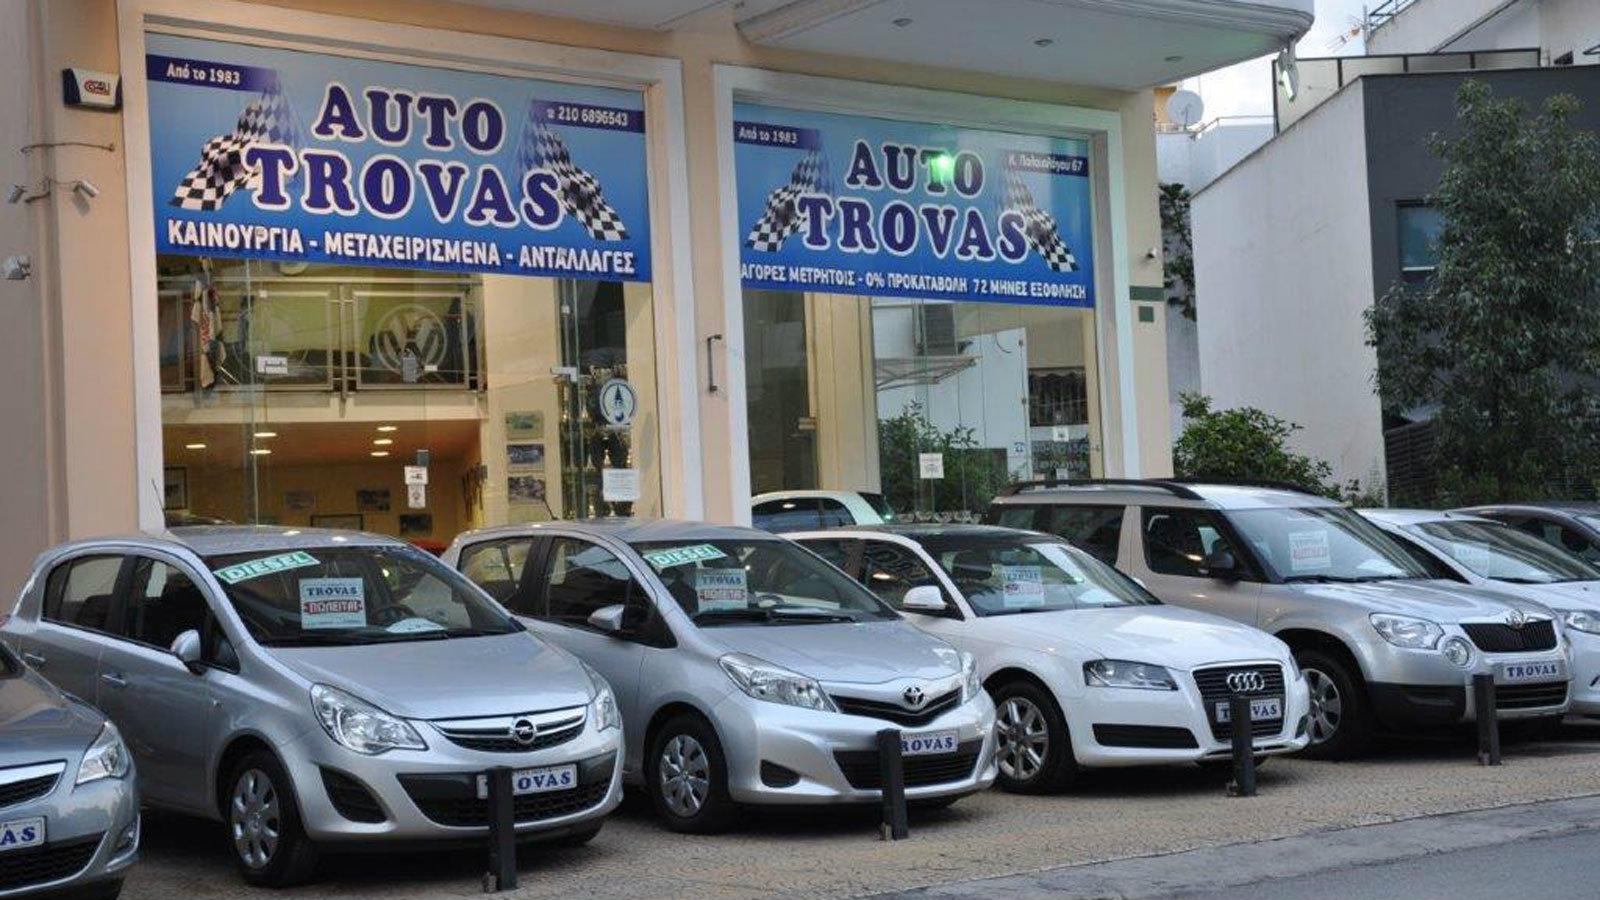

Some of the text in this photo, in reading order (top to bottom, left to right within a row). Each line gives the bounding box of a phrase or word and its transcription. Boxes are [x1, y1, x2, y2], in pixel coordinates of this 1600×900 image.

[166, 62, 240, 84] Από το 1983
[313, 83, 505, 152] AUTO
[558, 106, 578, 121] 210
[772, 130, 797, 144] 1983
[847, 141, 984, 197] AUTO
[1072, 160, 1082, 171] 67
[242, 145, 562, 230] TROVAS
[798, 194, 1028, 263] TROVAS
[168, 219, 303, 253] ΚΑΙΝΟΥΡΓΙΑ
[325, 231, 500, 266] ΜΕΤΑΧΕΙΡΙΣΜΕΝΑ
[741, 263, 786, 281] ΑΓΟΡΕΣ
[789, 266, 855, 286] ΜΕΤΡΗΤΟΙΣ
[866, 273, 885, 288] 0%
[887, 273, 967, 292] ΠΡΟΚΑΤΑΒΟΛΗ
[973, 279, 988, 293] 72
[990, 279, 1028, 296] ΜΗΝΕΣ
[1031, 282, 1086, 299] ΕΞΟΦΛΗΣΗ
[651, 545, 717, 566] DIESEL
[222, 552, 308, 581] DIESEL
[306, 586, 357, 597] TROVAS
[1507, 664, 1557, 677] TROVAS
[1220, 705, 1277, 719] TVAS
[900, 737, 952, 751] ROVAS
[518, 771, 571, 790] OVAS
[0, 827, 35, 846] AS
